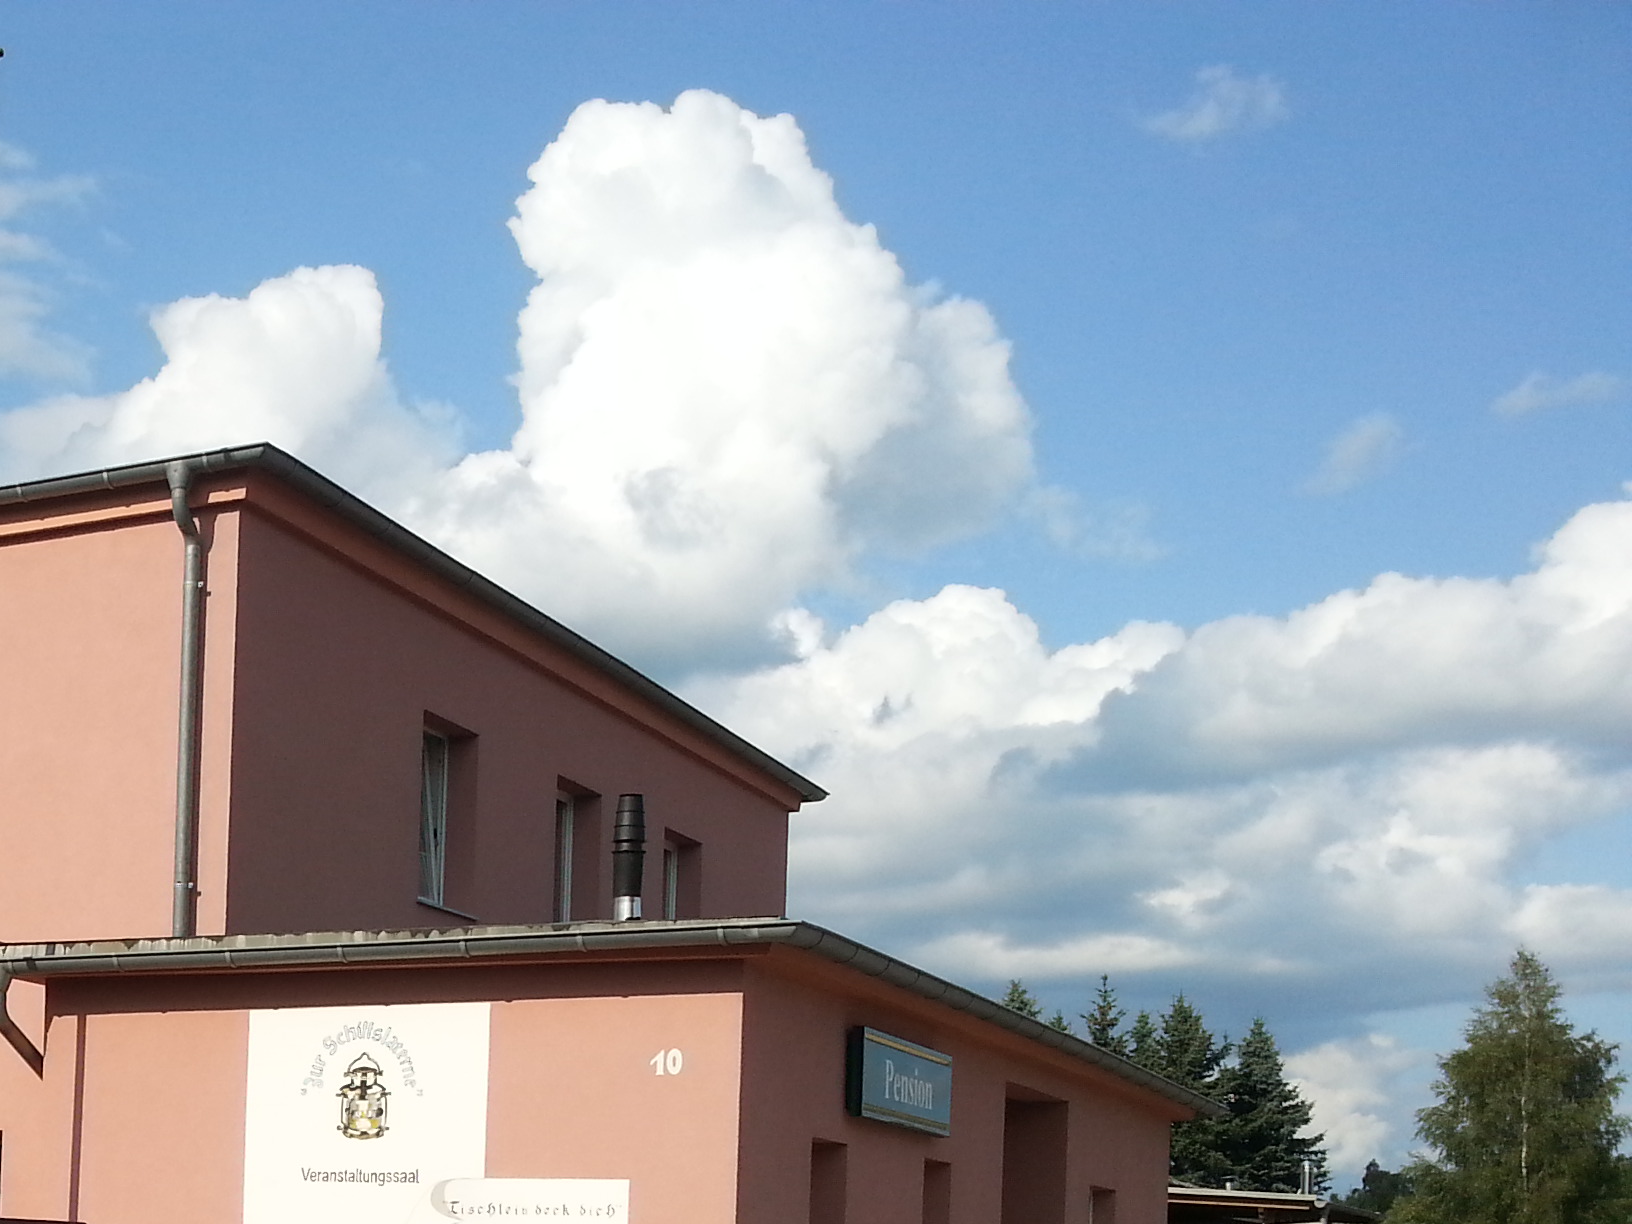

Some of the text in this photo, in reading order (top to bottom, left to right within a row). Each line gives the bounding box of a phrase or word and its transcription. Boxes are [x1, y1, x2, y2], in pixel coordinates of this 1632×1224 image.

[649, 1048, 683, 1076] 10
[883, 1059, 933, 1111] Pension
[301, 1167, 420, 1187] Veranstaltungssaal
[534, 1203, 570, 1217] deck
